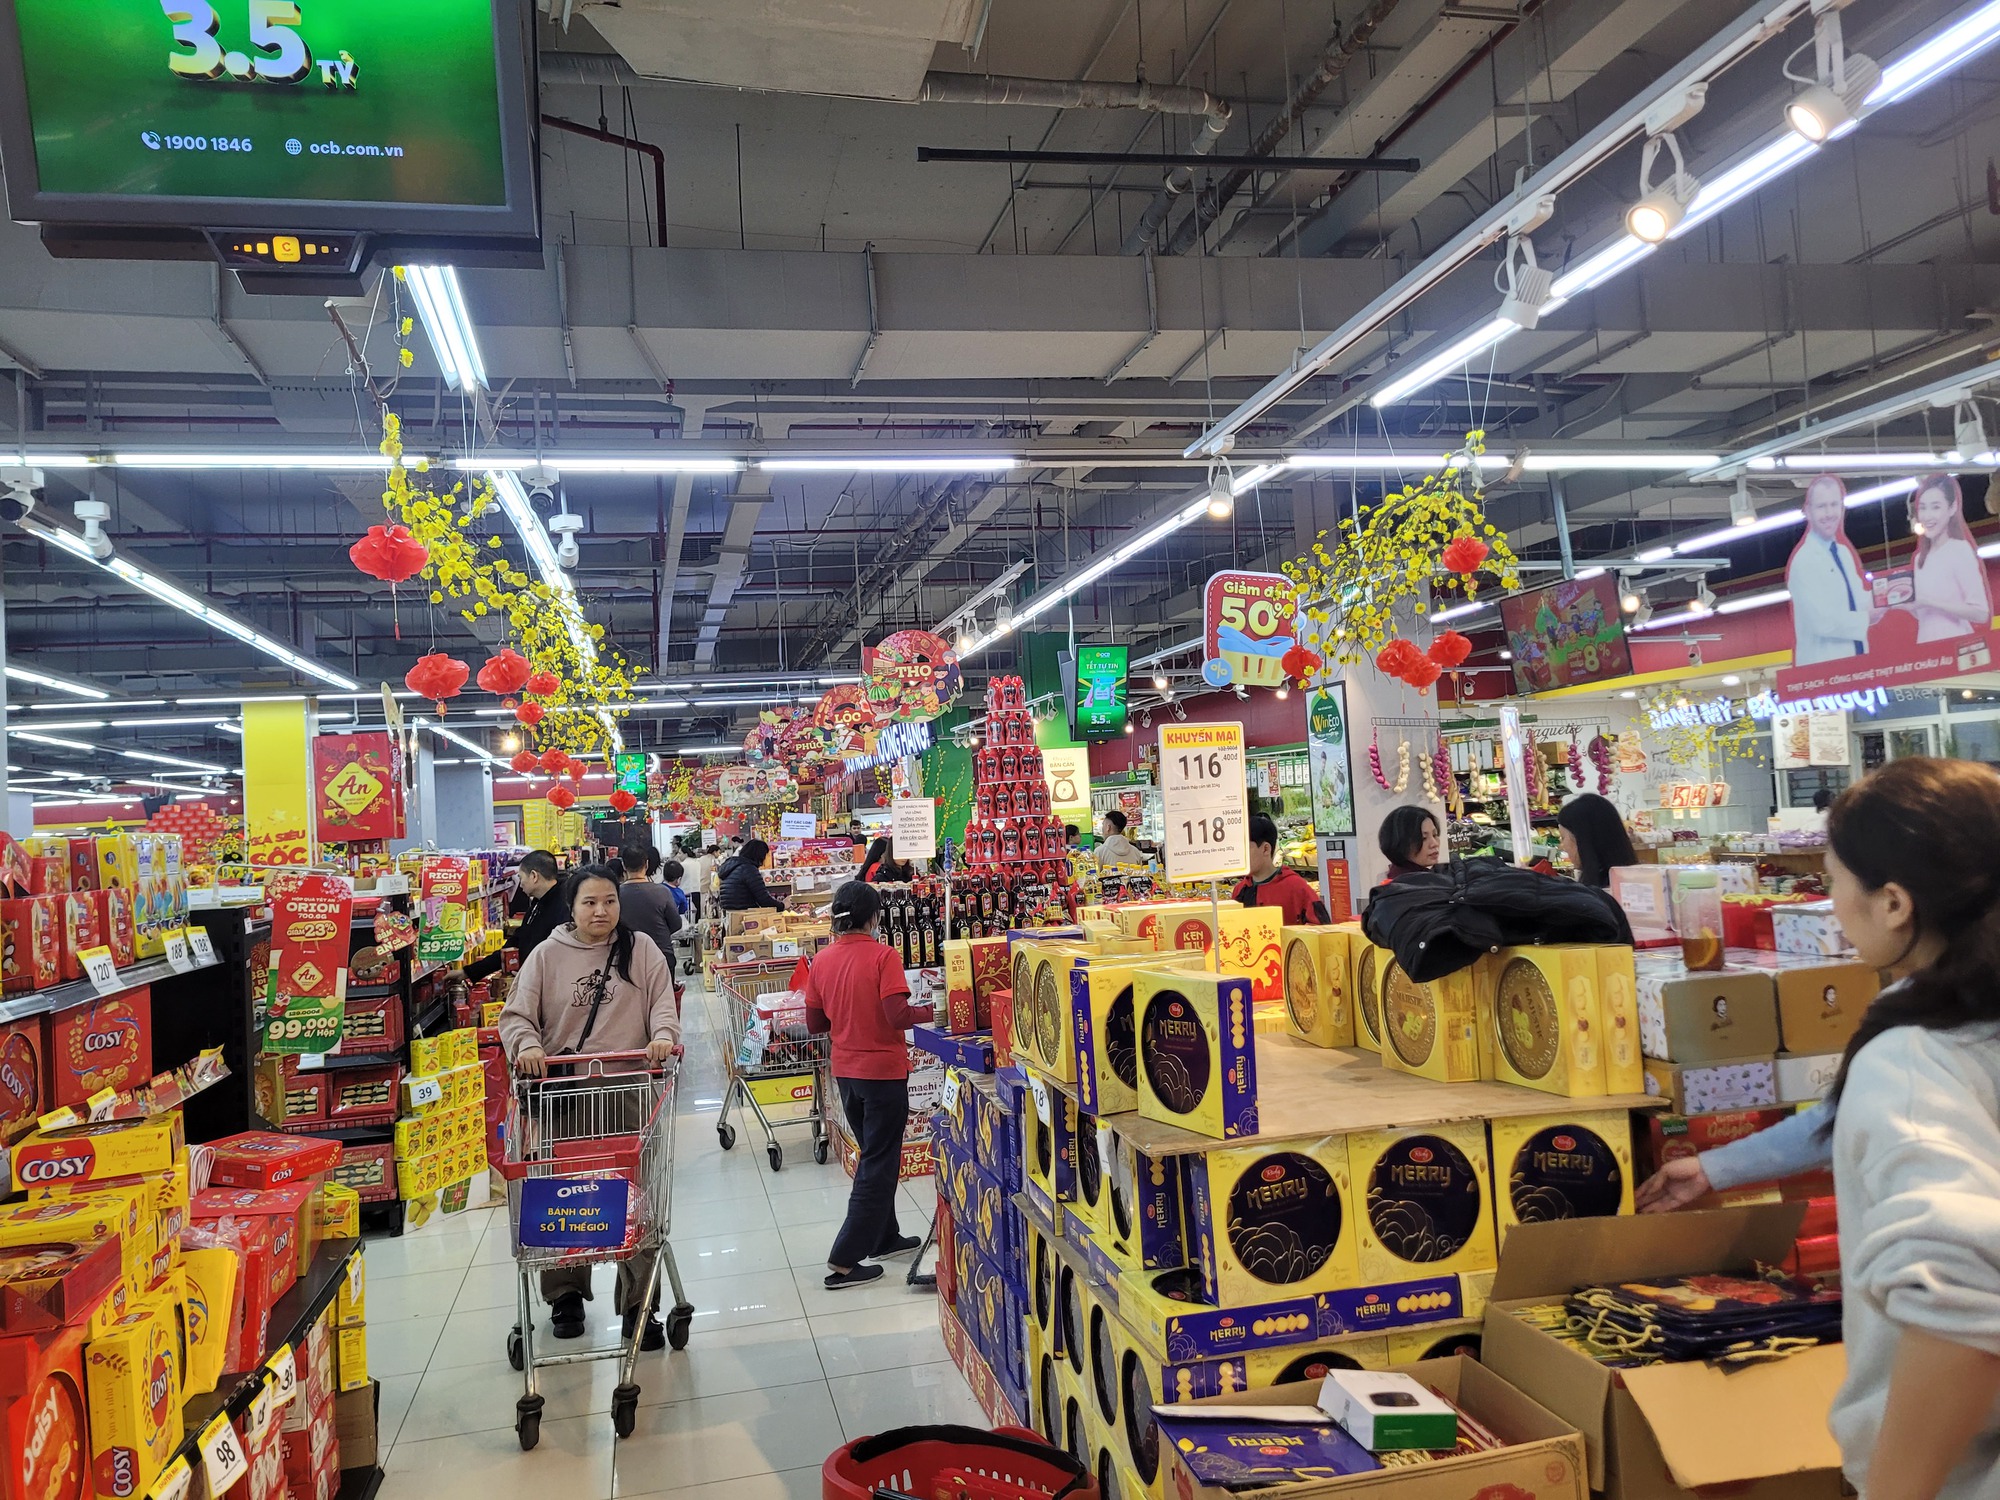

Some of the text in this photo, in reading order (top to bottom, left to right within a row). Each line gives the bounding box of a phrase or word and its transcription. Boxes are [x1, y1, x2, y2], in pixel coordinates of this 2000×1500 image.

[160, 0, 312, 84] 3.5
[164, 135, 253, 152] 1900 1846
[309, 141, 404, 157] ocb.com.vn
[1223, 581, 1260, 597] Giảm
[1219, 596, 1291, 637] 50%
[895, 665, 932, 680] THỌ
[1086, 661, 1097, 669] TẾT
[1804, 679, 1824, 691] SẠCH
[1829, 673, 1850, 686] CÔNG
[1852, 669, 1875, 682] NGHỆ
[1894, 686, 1945, 703] Bakery
[834, 710, 861, 726] LỘC
[1091, 714, 1106, 725] 3.5
[1312, 713, 1340, 732] WinEco
[1167, 728, 1237, 744] KHUYẾN MẠI
[1178, 752, 1222, 780] 116
[337, 774, 372, 798] An
[1182, 816, 1226, 845] 118
[286, 902, 340, 914] ORION
[305, 922, 335, 938] 23%
[1183, 931, 1204, 941] KEN
[778, 944, 790, 954] 16
[92, 963, 110, 982] 120
[268, 1016, 338, 1041] 99.000
[316, 1028, 336, 1039] Hộp
[1076, 1009, 1086, 1044] MERRY
[1159, 1019, 1197, 1042] MERRY
[84, 1029, 125, 1052] COSY
[1, 1063, 25, 1099] COSY
[1236, 1055, 1246, 1094] MERRY
[419, 1087, 432, 1099] 39
[794, 1086, 812, 1097] GIÁ
[945, 1085, 955, 1104] 52
[1034, 1087, 1044, 1108] 18
[1069, 1138, 1077, 1168] MERRY
[20, 1154, 93, 1183] COSY
[1533, 1151, 1594, 1175] MERRY
[271, 1167, 295, 1184] COSY
[1391, 1164, 1451, 1187] MERRY
[557, 1183, 600, 1198] OREO
[1246, 1176, 1309, 1211] MERRY
[547, 1206, 601, 1217] BÁNH QUY
[1155, 1192, 1166, 1229] MERRY
[540, 1221, 556, 1232] SỐ
[558, 1217, 566, 1232] 1
[569, 1220, 587, 1232] THẾ
[273, 1230, 289, 1256] COSY
[1356, 1302, 1391, 1318] MERRY
[1210, 1326, 1246, 1343] MERRY
[150, 1371, 167, 1409] COSY
[23, 1386, 59, 1487] Daisy
[1227, 1436, 1305, 1448] MERRY
[215, 1440, 236, 1470] 98
[112, 1446, 134, 1498] COSY
